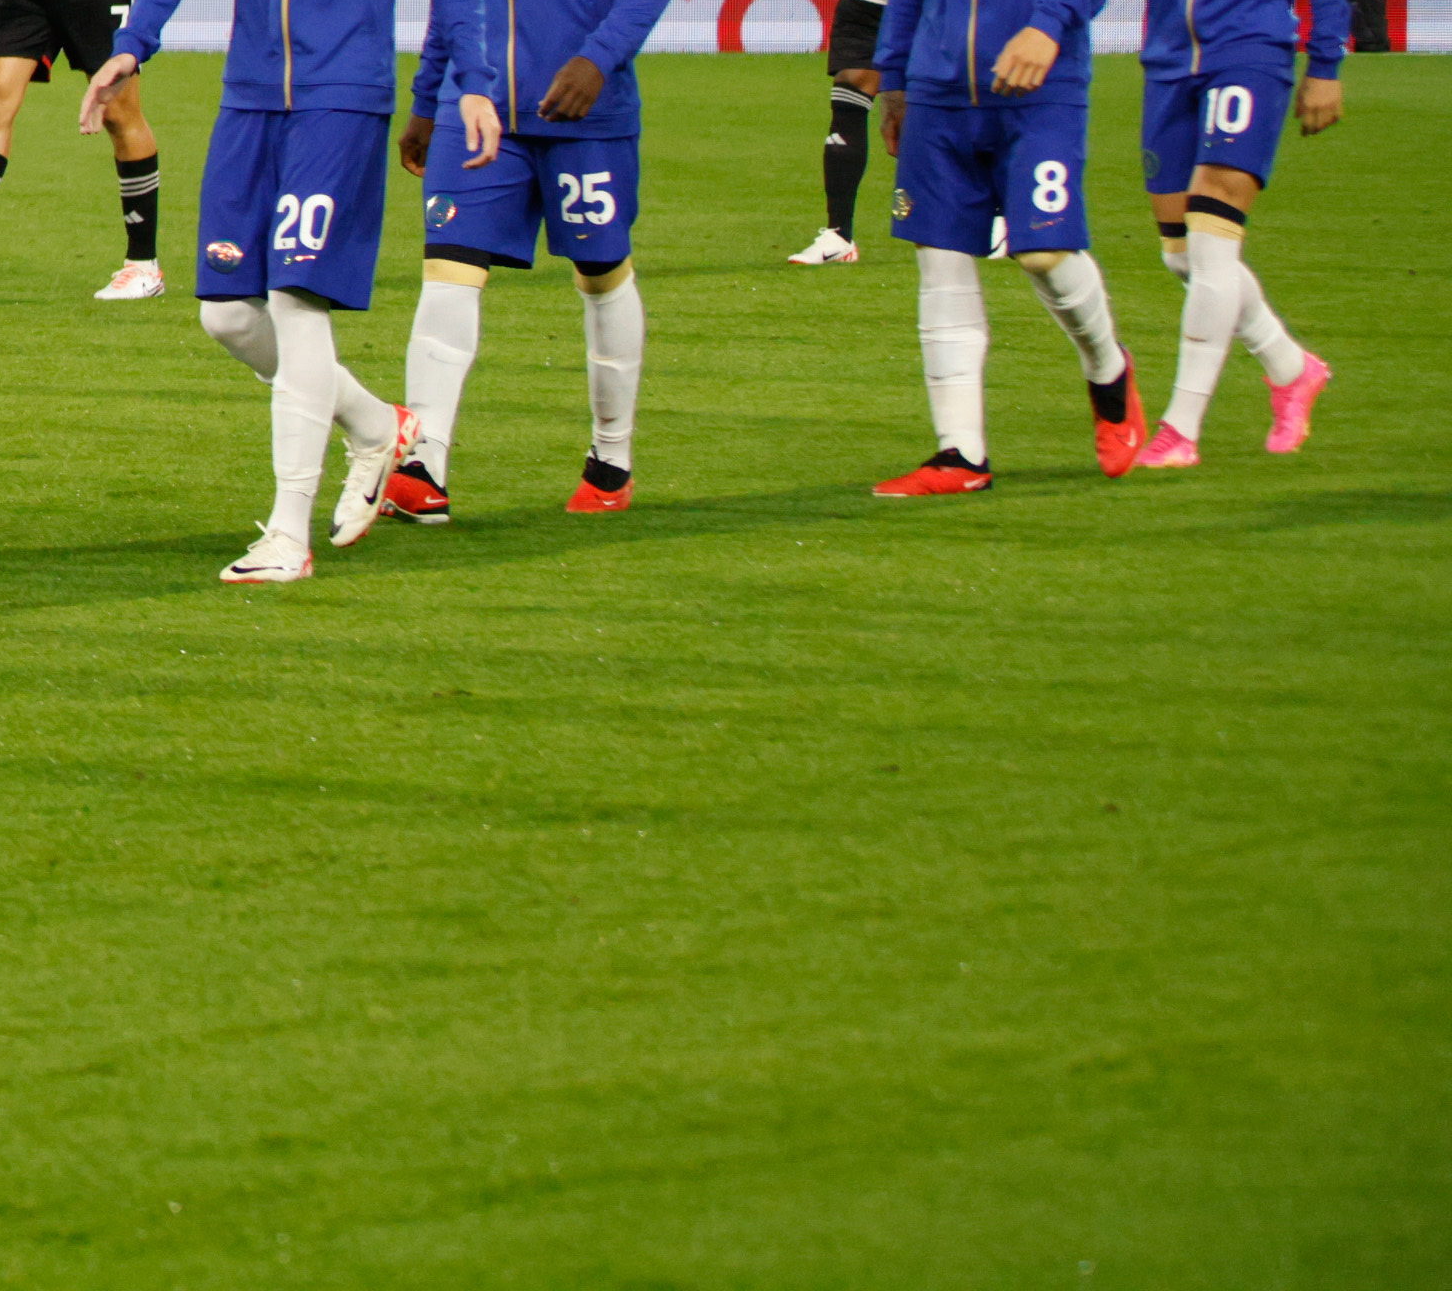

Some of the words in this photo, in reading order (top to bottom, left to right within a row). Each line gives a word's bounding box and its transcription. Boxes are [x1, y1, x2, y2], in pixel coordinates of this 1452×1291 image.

[1205, 85, 1254, 135] 10
[558, 171, 616, 225] 25
[1032, 160, 1070, 213] 8
[273, 193, 334, 251] 20
